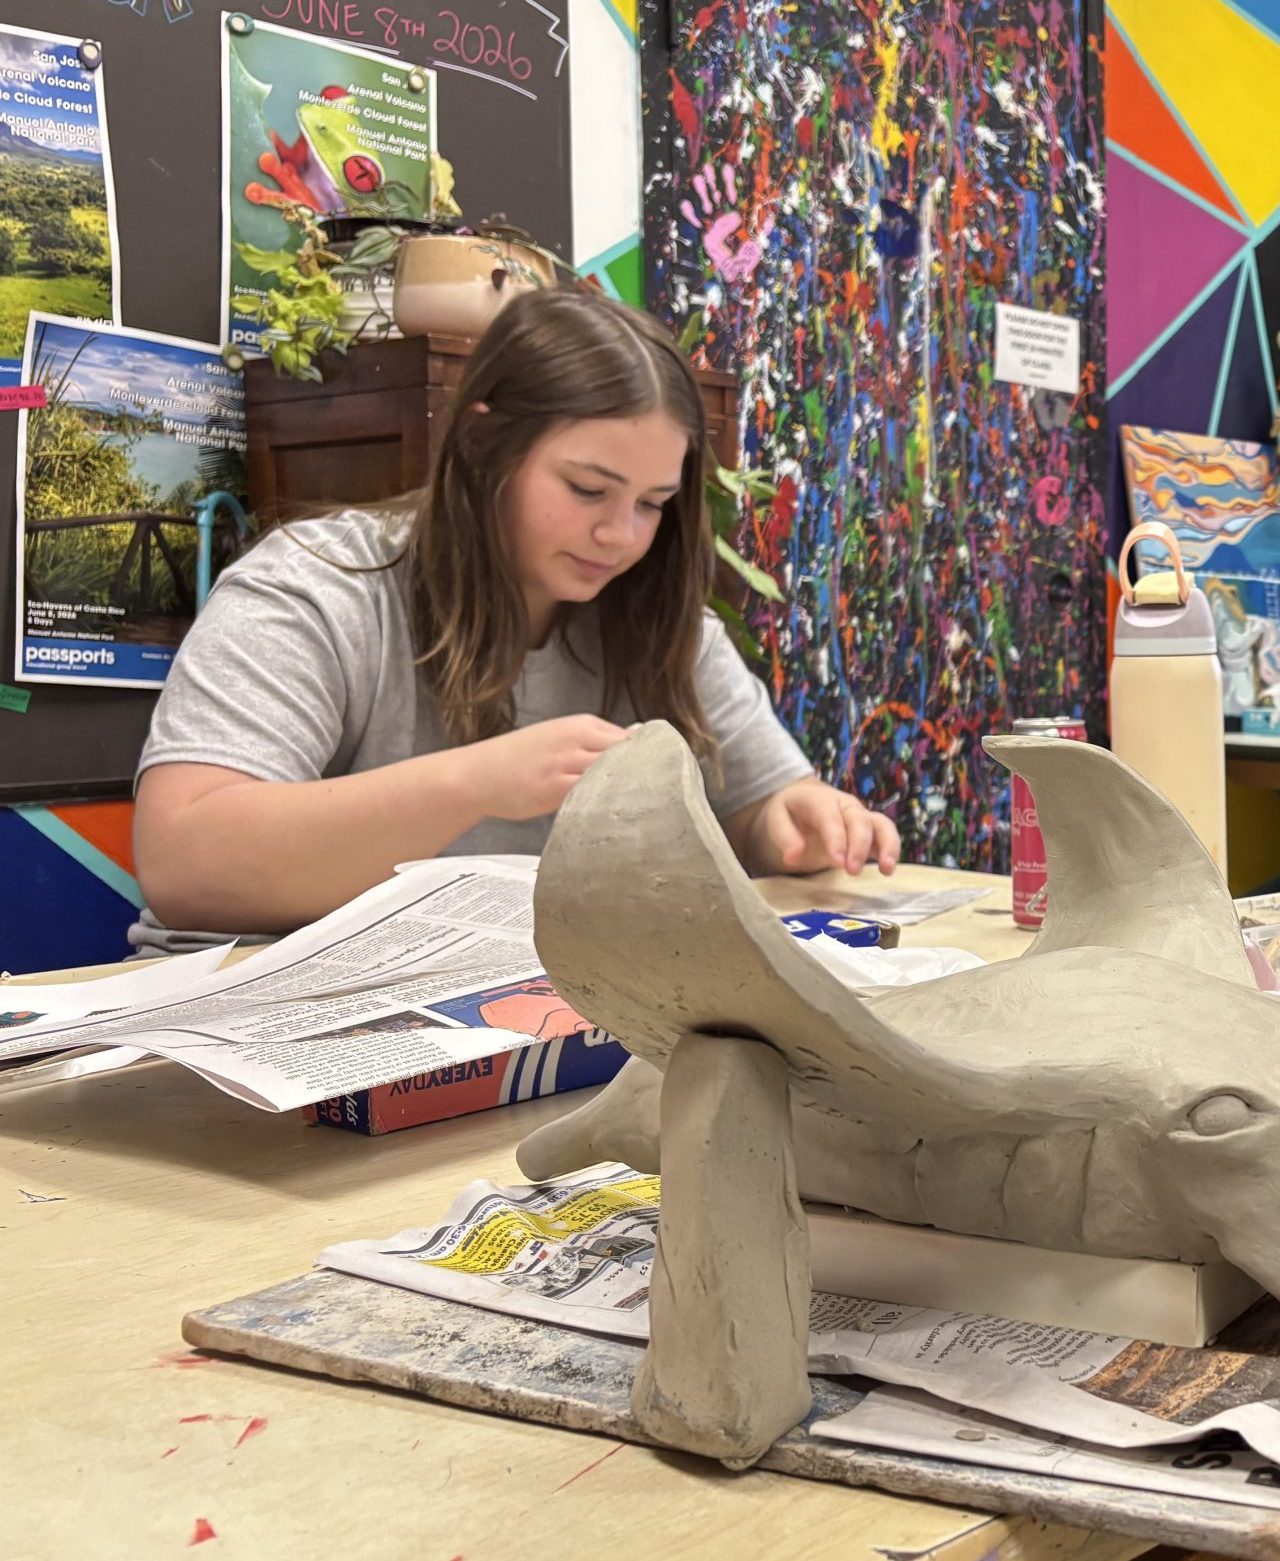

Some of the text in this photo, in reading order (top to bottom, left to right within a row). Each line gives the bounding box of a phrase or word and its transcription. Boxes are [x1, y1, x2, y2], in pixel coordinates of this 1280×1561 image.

[375, 8, 426, 46] 8TH
[433, 10, 532, 80] 2026
[33, 50, 82, 68] San Jos
[39, 73, 91, 92] Volcano
[14, 92, 53, 107] Cloud
[56, 99, 93, 114] Forest
[347, 84, 383, 101] Arenal
[385, 93, 427, 113] Volcano
[299, 90, 427, 133] Monteverde Cloud Forest
[10, 126, 96, 147] National Park
[47, 119, 95, 136] Antonio
[346, 123, 427, 152] Manuel Antonio
[358, 137, 427, 162] National Park
[206, 362, 227, 376] San
[167, 377, 245, 399] Arenal Volca
[110, 388, 246, 420] Monteverde Cloud Fore
[163, 418, 247, 439] Manuel Antoni
[175, 431, 226, 448] National
[84, 604, 107, 614] Costa
[26, 645, 115, 665] passports
[390, 1055, 493, 1096] EVERYDAY
[547, 1190, 569, 1203] 6:30
[447, 1225, 467, 1246] 6:30
[920, 1327, 940, 1352] clarity
